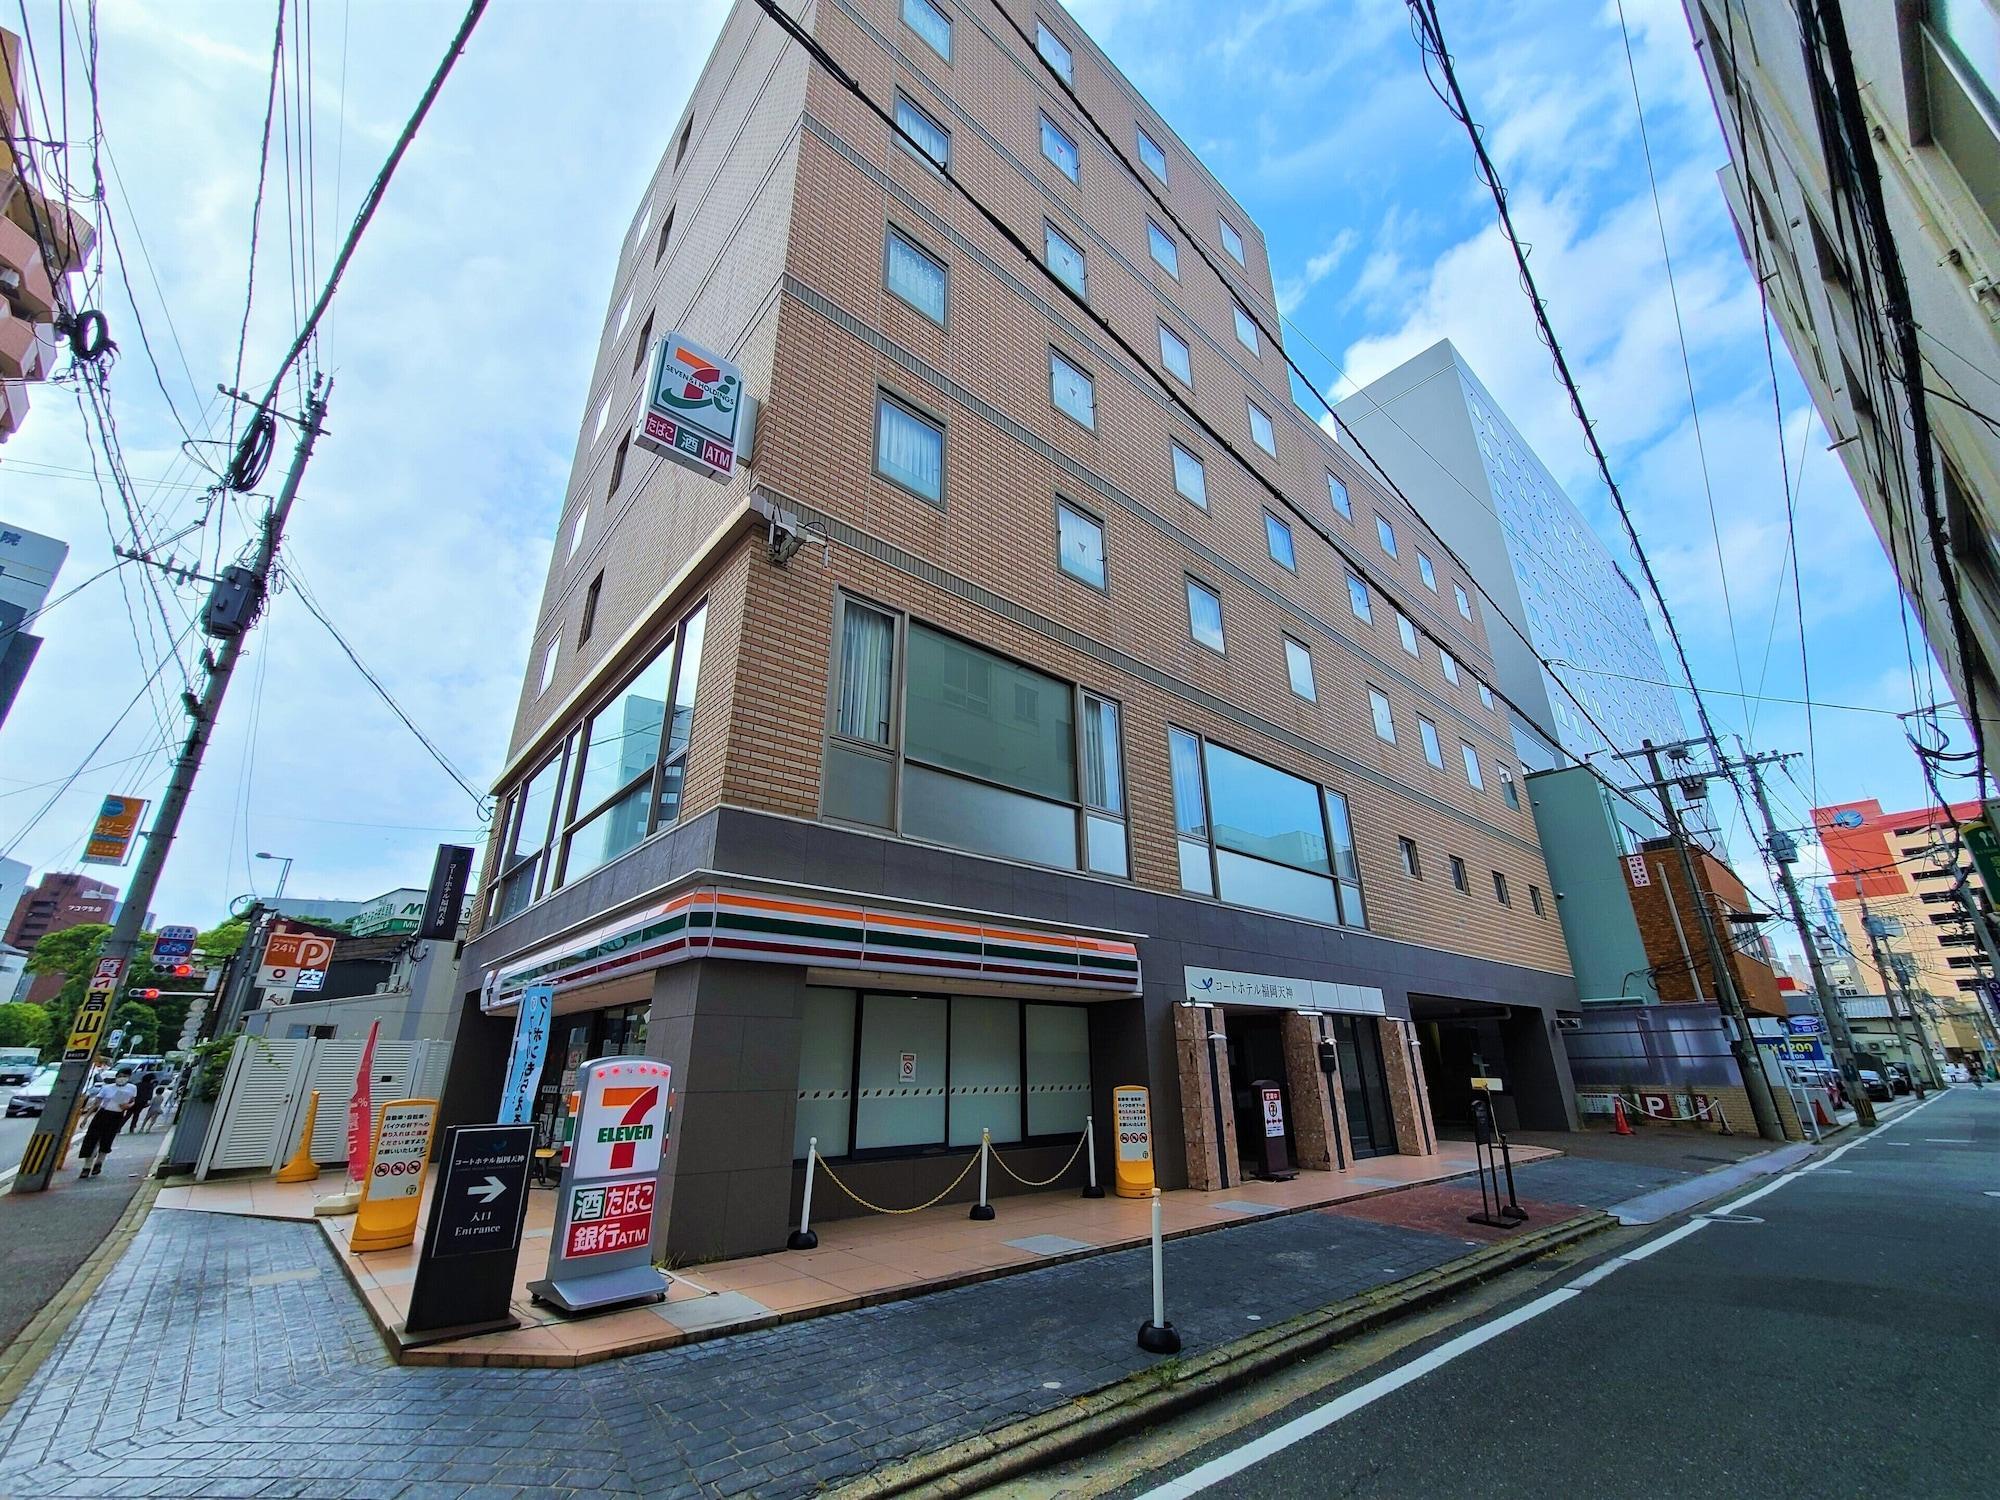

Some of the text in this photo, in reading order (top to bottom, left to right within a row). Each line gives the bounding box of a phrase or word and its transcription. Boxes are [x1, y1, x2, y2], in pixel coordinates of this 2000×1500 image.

[646, 416, 674, 442] たばこ
[680, 431, 699, 454] 酒
[705, 445, 730, 468] ATM
[270, 943, 297, 953] 24h
[295, 939, 330, 967] P
[1215, 980, 1294, 1000] コートホテル福岡天神
[1645, 1096, 1665, 1117] P
[455, 1154, 525, 1166] コートホテル福岡天神
[573, 1185, 653, 1221] 酒 たばこ
[470, 1210, 492, 1223] 入口
[455, 1225, 501, 1237] Entrance
